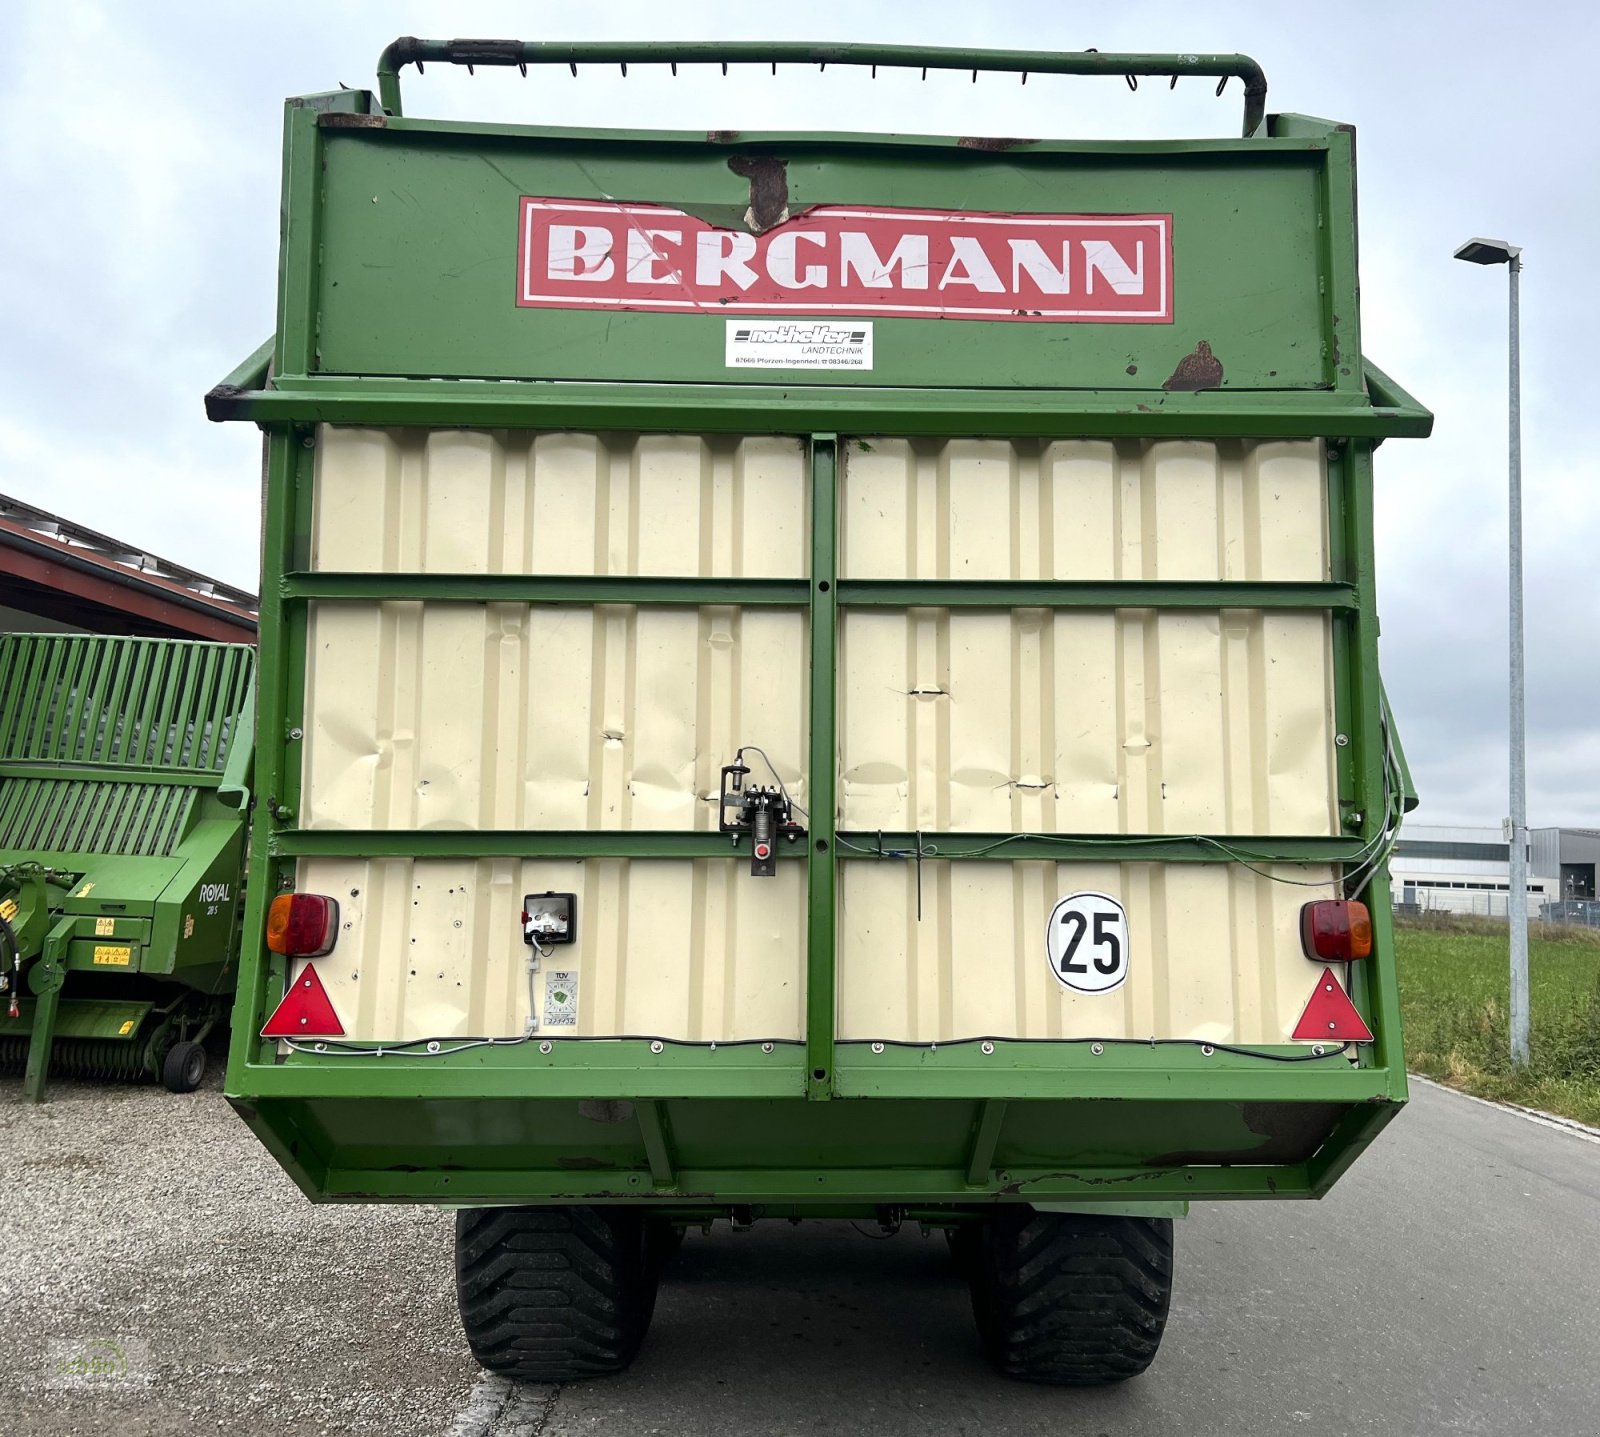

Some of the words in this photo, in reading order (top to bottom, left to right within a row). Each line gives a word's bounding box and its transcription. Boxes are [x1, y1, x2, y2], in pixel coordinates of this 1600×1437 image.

[547, 224, 1144, 295] BERGMANN
[750, 325, 851, 343] nothelfer
[801, 346, 863, 355] LANDTECHNIK
[199, 883, 230, 902] ROYAL
[1060, 910, 1121, 975] 25
